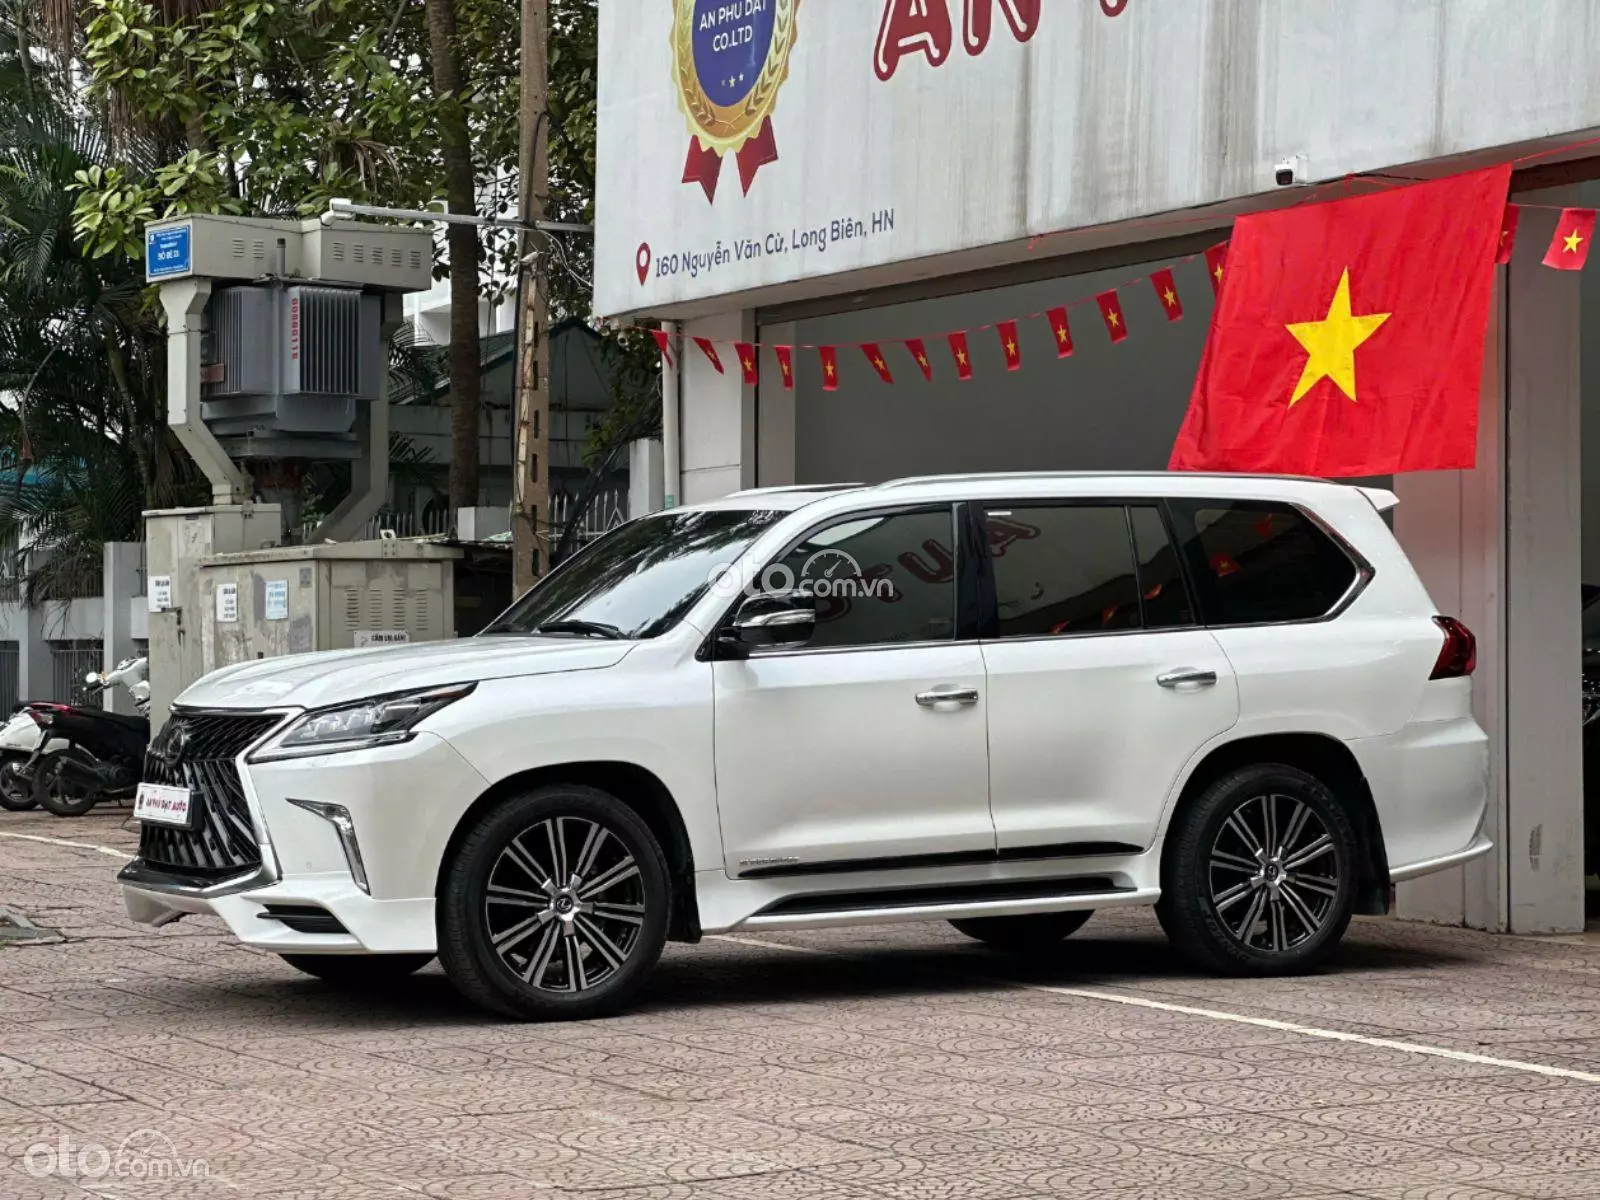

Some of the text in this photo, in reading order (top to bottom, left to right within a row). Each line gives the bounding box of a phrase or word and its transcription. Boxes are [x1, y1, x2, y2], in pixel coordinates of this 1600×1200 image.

[699, 10, 717, 31] AN
[712, 25, 753, 52] CO.LTD
[655, 253, 679, 278] 160
[682, 240, 730, 278] Nguyễn
[734, 239, 761, 261] Văn
[792, 228, 827, 252] Long
[831, 217, 867, 242] Biên,
[872, 208, 894, 234] HN
